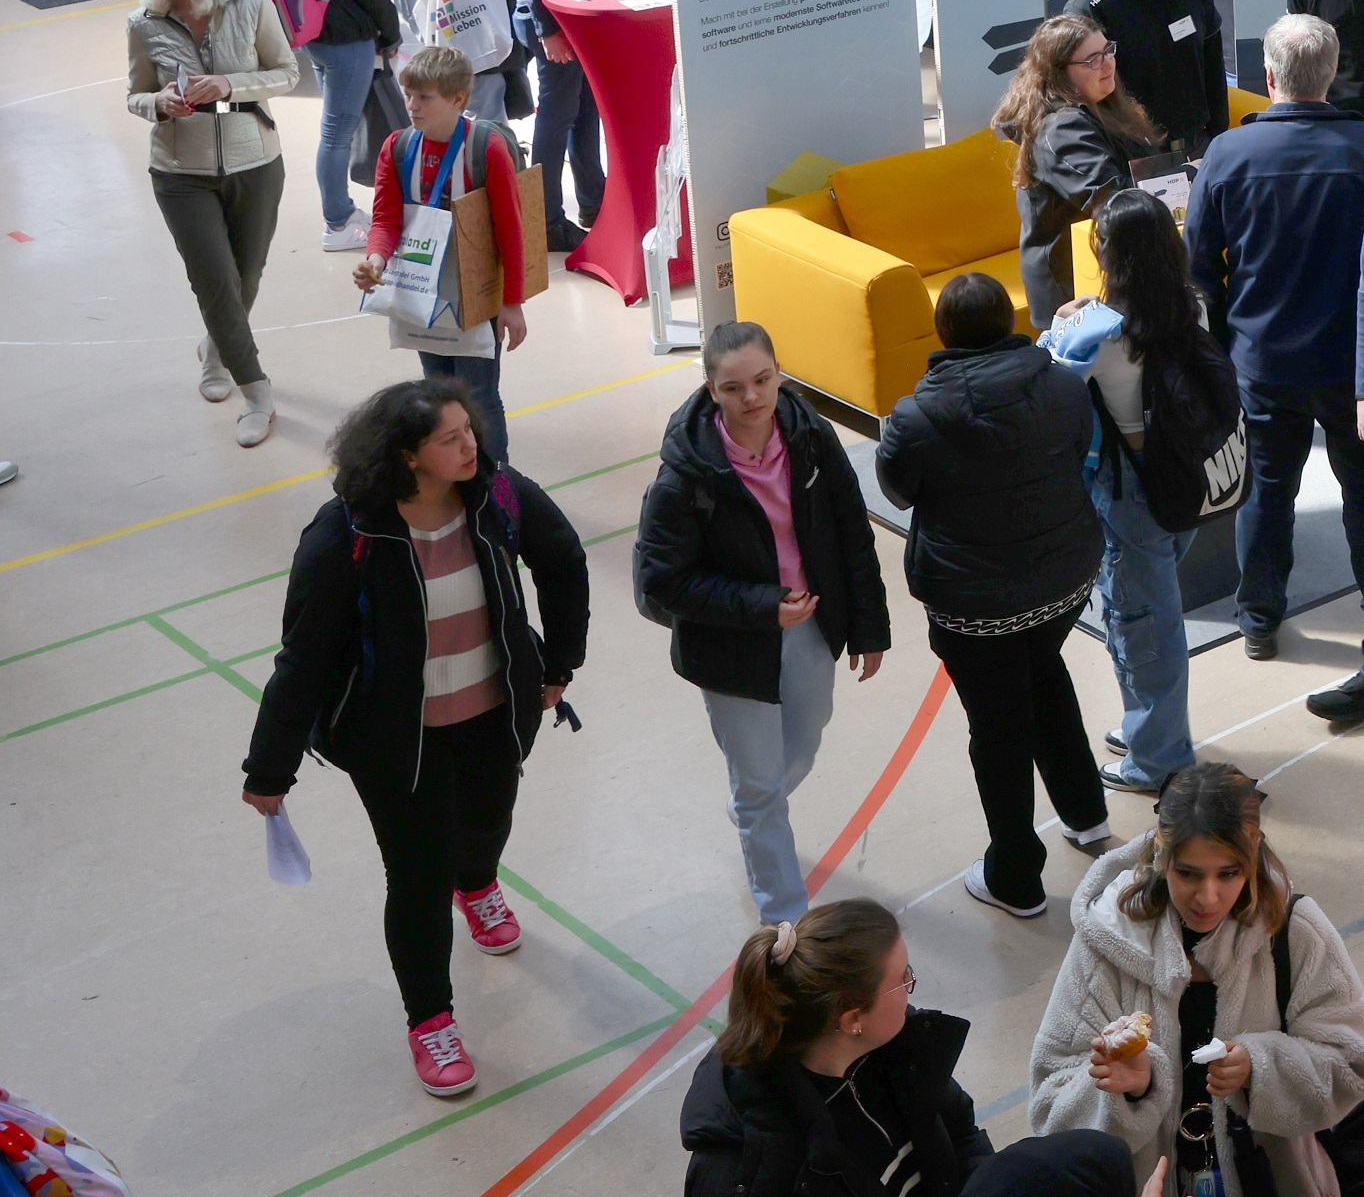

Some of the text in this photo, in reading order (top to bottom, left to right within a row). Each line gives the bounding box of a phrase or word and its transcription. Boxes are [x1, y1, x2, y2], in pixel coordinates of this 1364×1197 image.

[448, 3, 487, 25] Mission
[452, 16, 482, 35] Leben
[701, 23, 737, 39] software
[410, 272, 430, 284] GmbH
